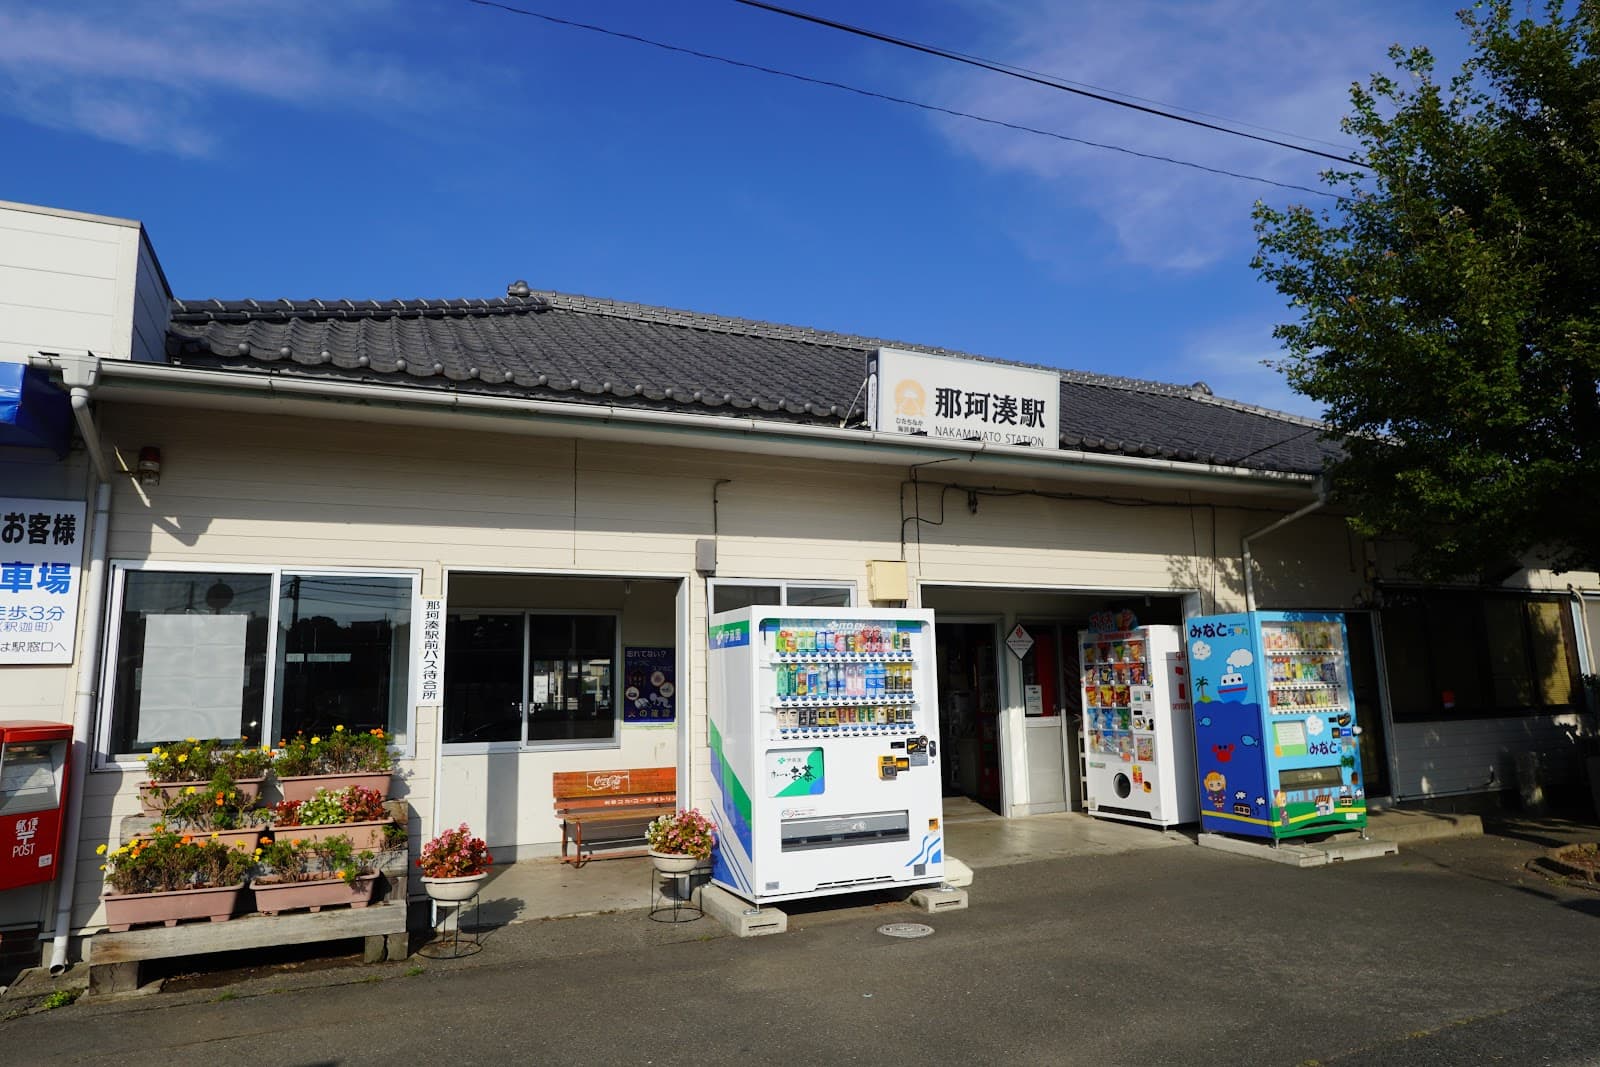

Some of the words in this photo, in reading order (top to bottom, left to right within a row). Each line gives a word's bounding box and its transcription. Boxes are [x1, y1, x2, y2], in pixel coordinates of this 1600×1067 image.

[935, 387, 1046, 429] 那珂湊駅
[935, 425, 1001, 442] NAKAMINATO
[1005, 432, 1044, 447] STATION
[0, 512, 76, 545] お客様
[0, 561, 72, 594] 車場
[422, 600, 441, 700] 那珂湊駅前バス待合所
[16, 817, 39, 833] 郵便
[12, 843, 36, 858] POST
